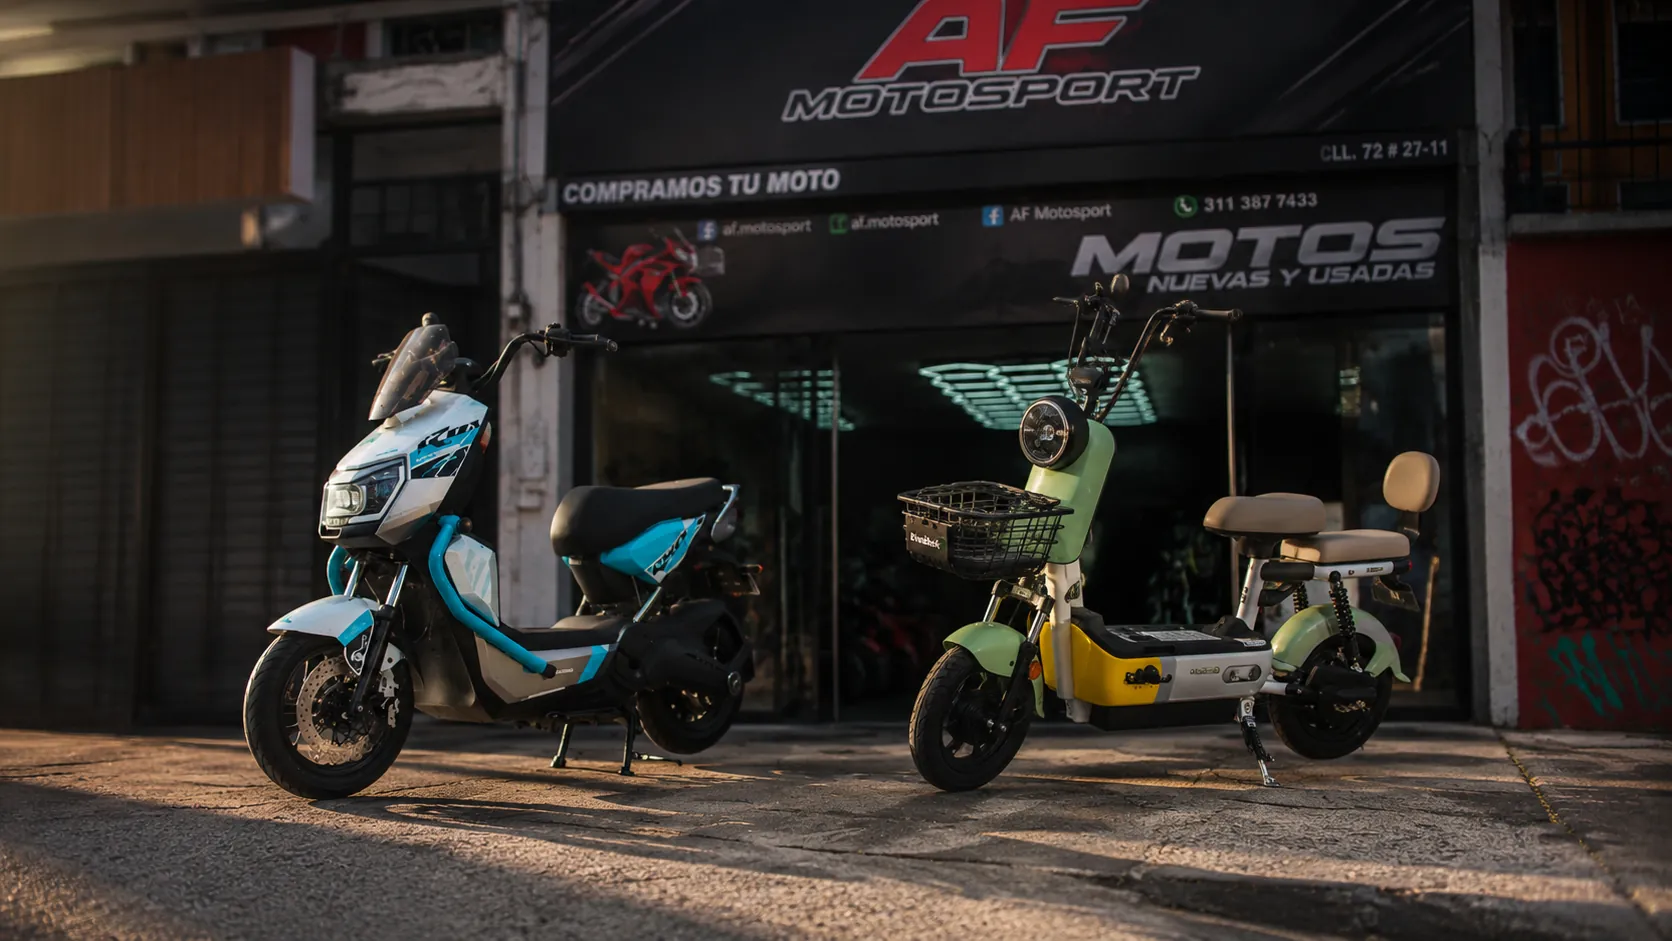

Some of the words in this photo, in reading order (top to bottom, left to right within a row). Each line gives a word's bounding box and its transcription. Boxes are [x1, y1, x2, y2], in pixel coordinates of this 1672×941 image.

[852, 0, 1149, 84] AF
[781, 66, 1201, 122] MOTOSPORT
[1320, 144, 1356, 162] CLL.
[1362, 143, 1383, 160] 72
[1387, 143, 1398, 158] #
[1402, 139, 1448, 158] 27-11
[563, 176, 722, 204] COMPRAMOS
[728, 174, 760, 196] TU
[766, 168, 841, 194] MOTO
[1009, 207, 1031, 222] AF
[1034, 203, 1112, 221] Motosport
[1204, 197, 1235, 212] 311
[1240, 194, 1271, 210] 387
[1275, 192, 1319, 209] 7433
[722, 219, 812, 236] af.motosport
[851, 212, 940, 230] af.motosport
[1070, 216, 1447, 277] MOTOS
[1146, 269, 1270, 293] NUEVAS
[1279, 267, 1301, 287] Y
[1307, 261, 1436, 284] USADAS
